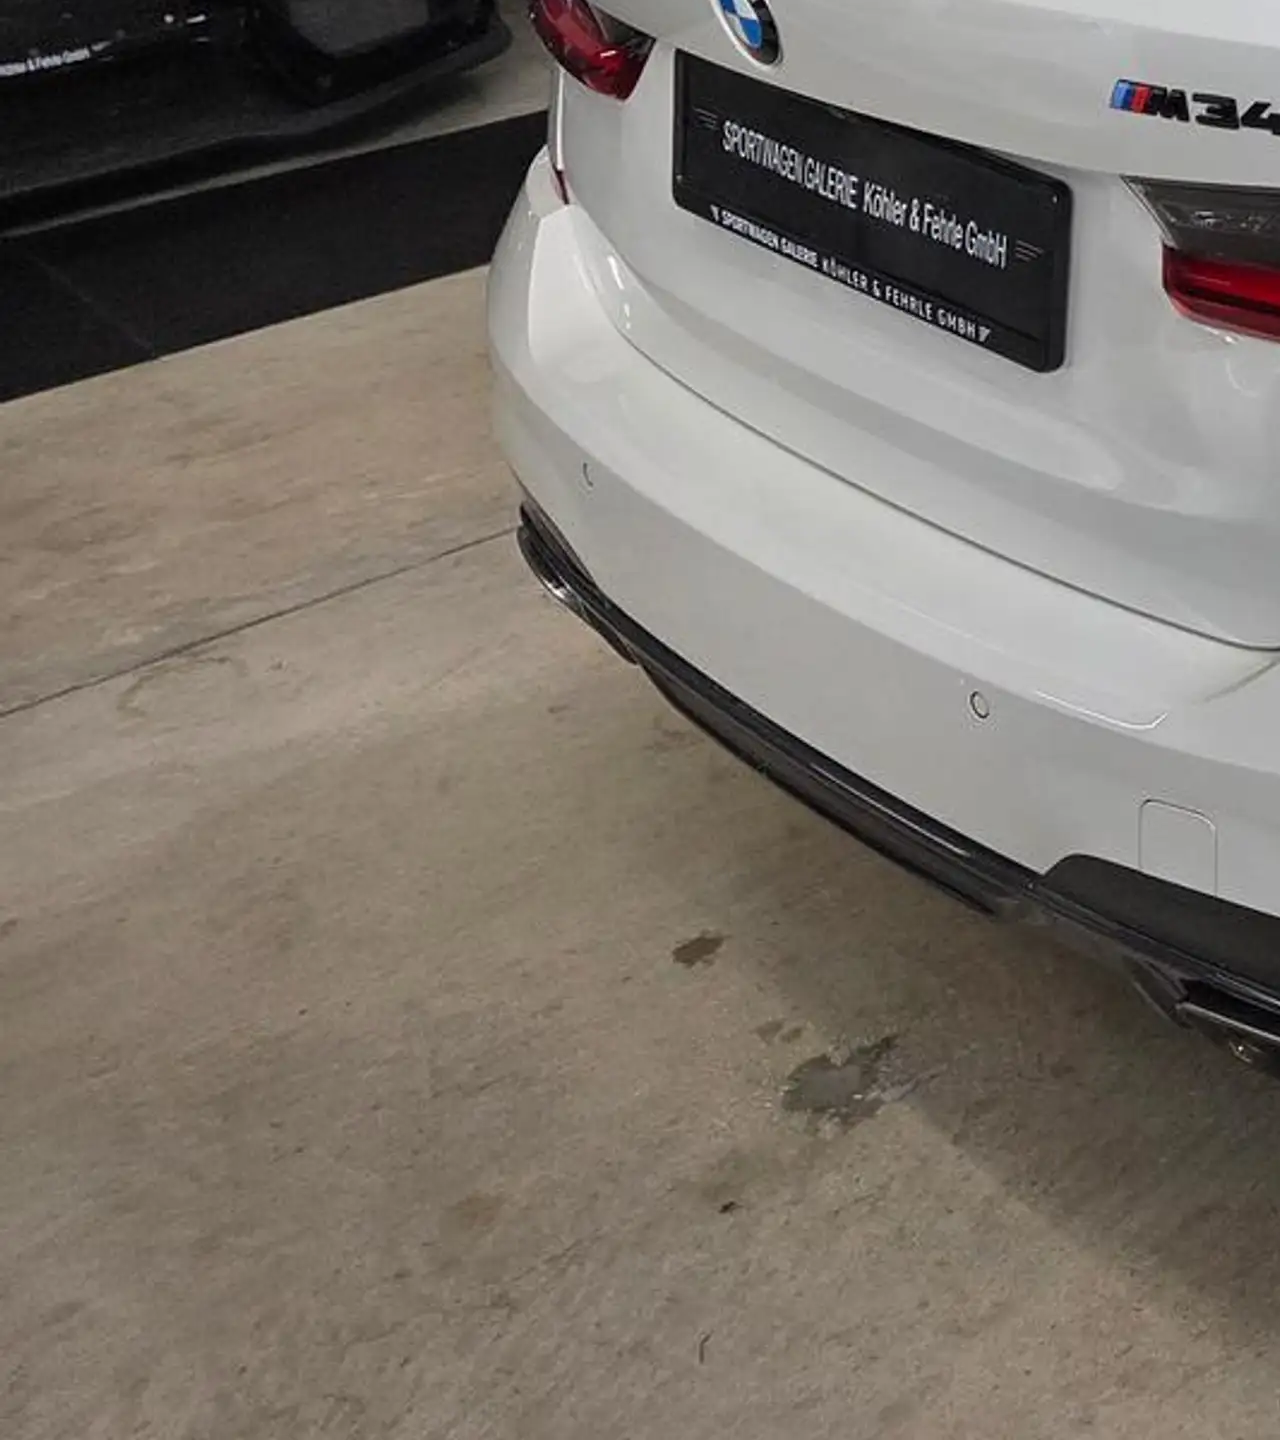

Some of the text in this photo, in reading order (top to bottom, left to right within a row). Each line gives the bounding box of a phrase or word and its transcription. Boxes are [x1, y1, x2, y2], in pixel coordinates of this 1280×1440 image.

[722, 120, 1007, 270] SPORTWAGEN GALERIE Köhler & Fehrle GmbH
[721, 210, 976, 339] SPORTWAGEN GALERIE KÖHLER & FEHRLE GMBH
